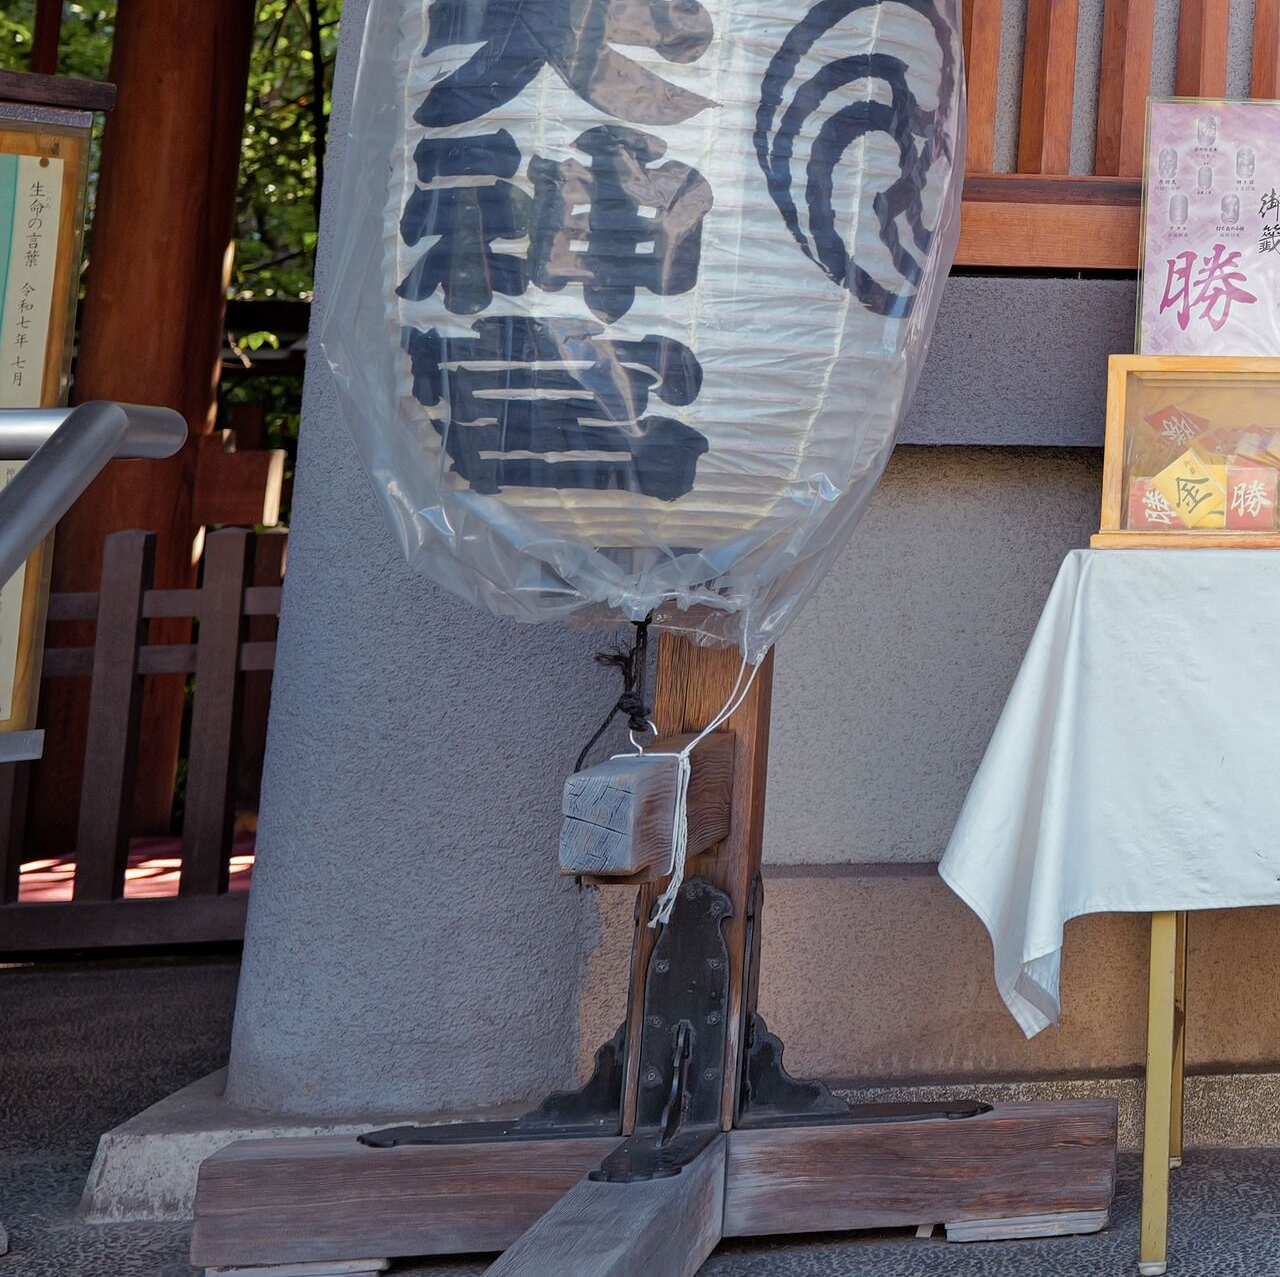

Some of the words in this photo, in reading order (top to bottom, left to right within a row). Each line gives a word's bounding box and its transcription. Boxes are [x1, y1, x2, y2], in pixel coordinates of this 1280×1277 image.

[25, 181, 46, 268] 生命の言葉
[1159, 243, 1257, 331] 勝
[15, 282, 35, 350] 令和七年
[10, 355, 26, 388] 七月
[1176, 476, 1213, 515] 金
[1231, 479, 1272, 517] 勝
